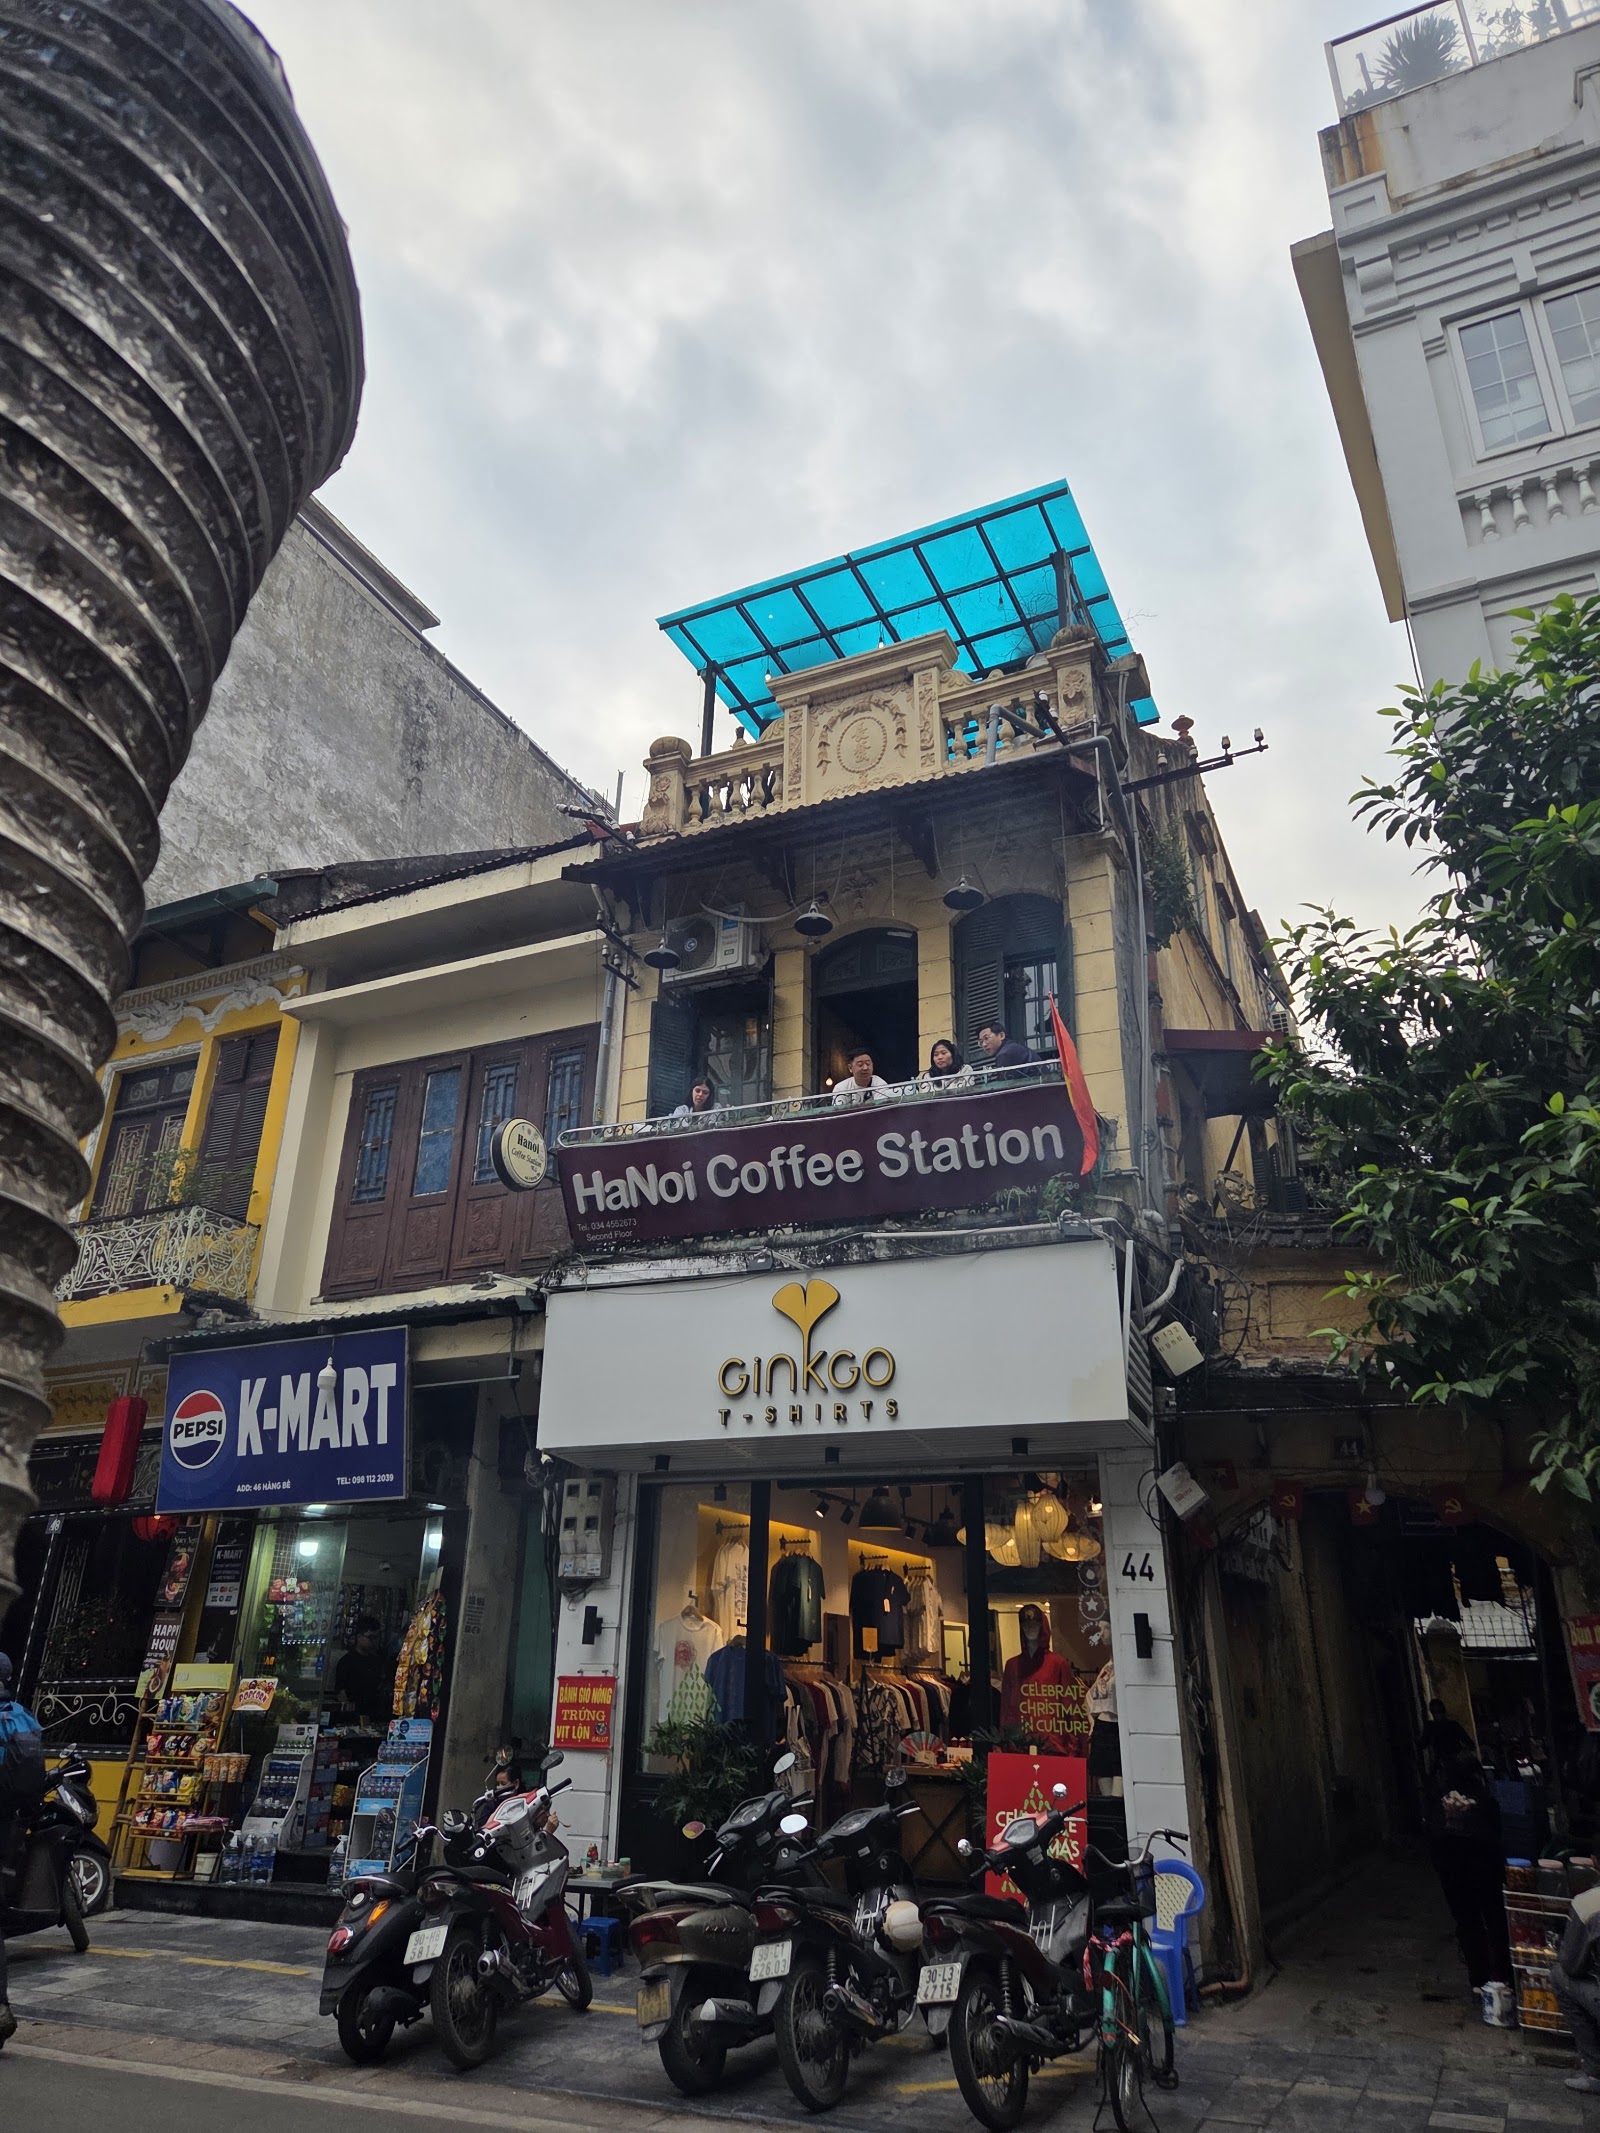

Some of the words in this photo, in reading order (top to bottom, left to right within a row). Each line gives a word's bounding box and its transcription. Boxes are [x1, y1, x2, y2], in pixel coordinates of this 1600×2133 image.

[517, 1134, 540, 1154] Hanoi
[511, 1147, 526, 1161] Coffee
[572, 1161, 697, 1214] HaNoi
[706, 1144, 865, 1198] Coffee
[876, 1122, 1064, 1178] Station
[577, 1223, 590, 1231] Tel:
[591, 1221, 605, 1230] 034
[586, 1231, 613, 1241] Second
[614, 1230, 633, 1238] Floor
[237, 1362, 397, 1457] K-MART
[718, 1399, 899, 1426] T-SHIRTS
[173, 1419, 223, 1439] PEPSI
[236, 1484, 252, 1493] ADD:
[253, 1483, 262, 1491] 46
[336, 1476, 350, 1485] TEL:
[352, 1475, 366, 1484] 098
[366, 1475, 376, 1483] 112
[377, 1474, 394, 1483] 2039
[216, 1549, 244, 1560] K-MART
[1122, 1552, 1154, 1581] 44
[151, 1638, 176, 1650] HOUR
[559, 1683, 578, 1703] BÁNH
[579, 1683, 591, 1703] GIÒ
[592, 1684, 613, 1704] NÓNG
[1021, 1682, 1086, 1700] CELEBRATE
[556, 1725, 571, 1742] VỊT
[572, 1723, 591, 1742] LỘN
[1036, 1717, 1089, 1736] CULTURE
[410, 1944, 438, 1960] 5812
[758, 1943, 785, 1962] 99-C1
[752, 1959, 787, 1978] 526.03
[926, 1966, 954, 1984] 30-L3
[923, 1983, 952, 2000] 4715
